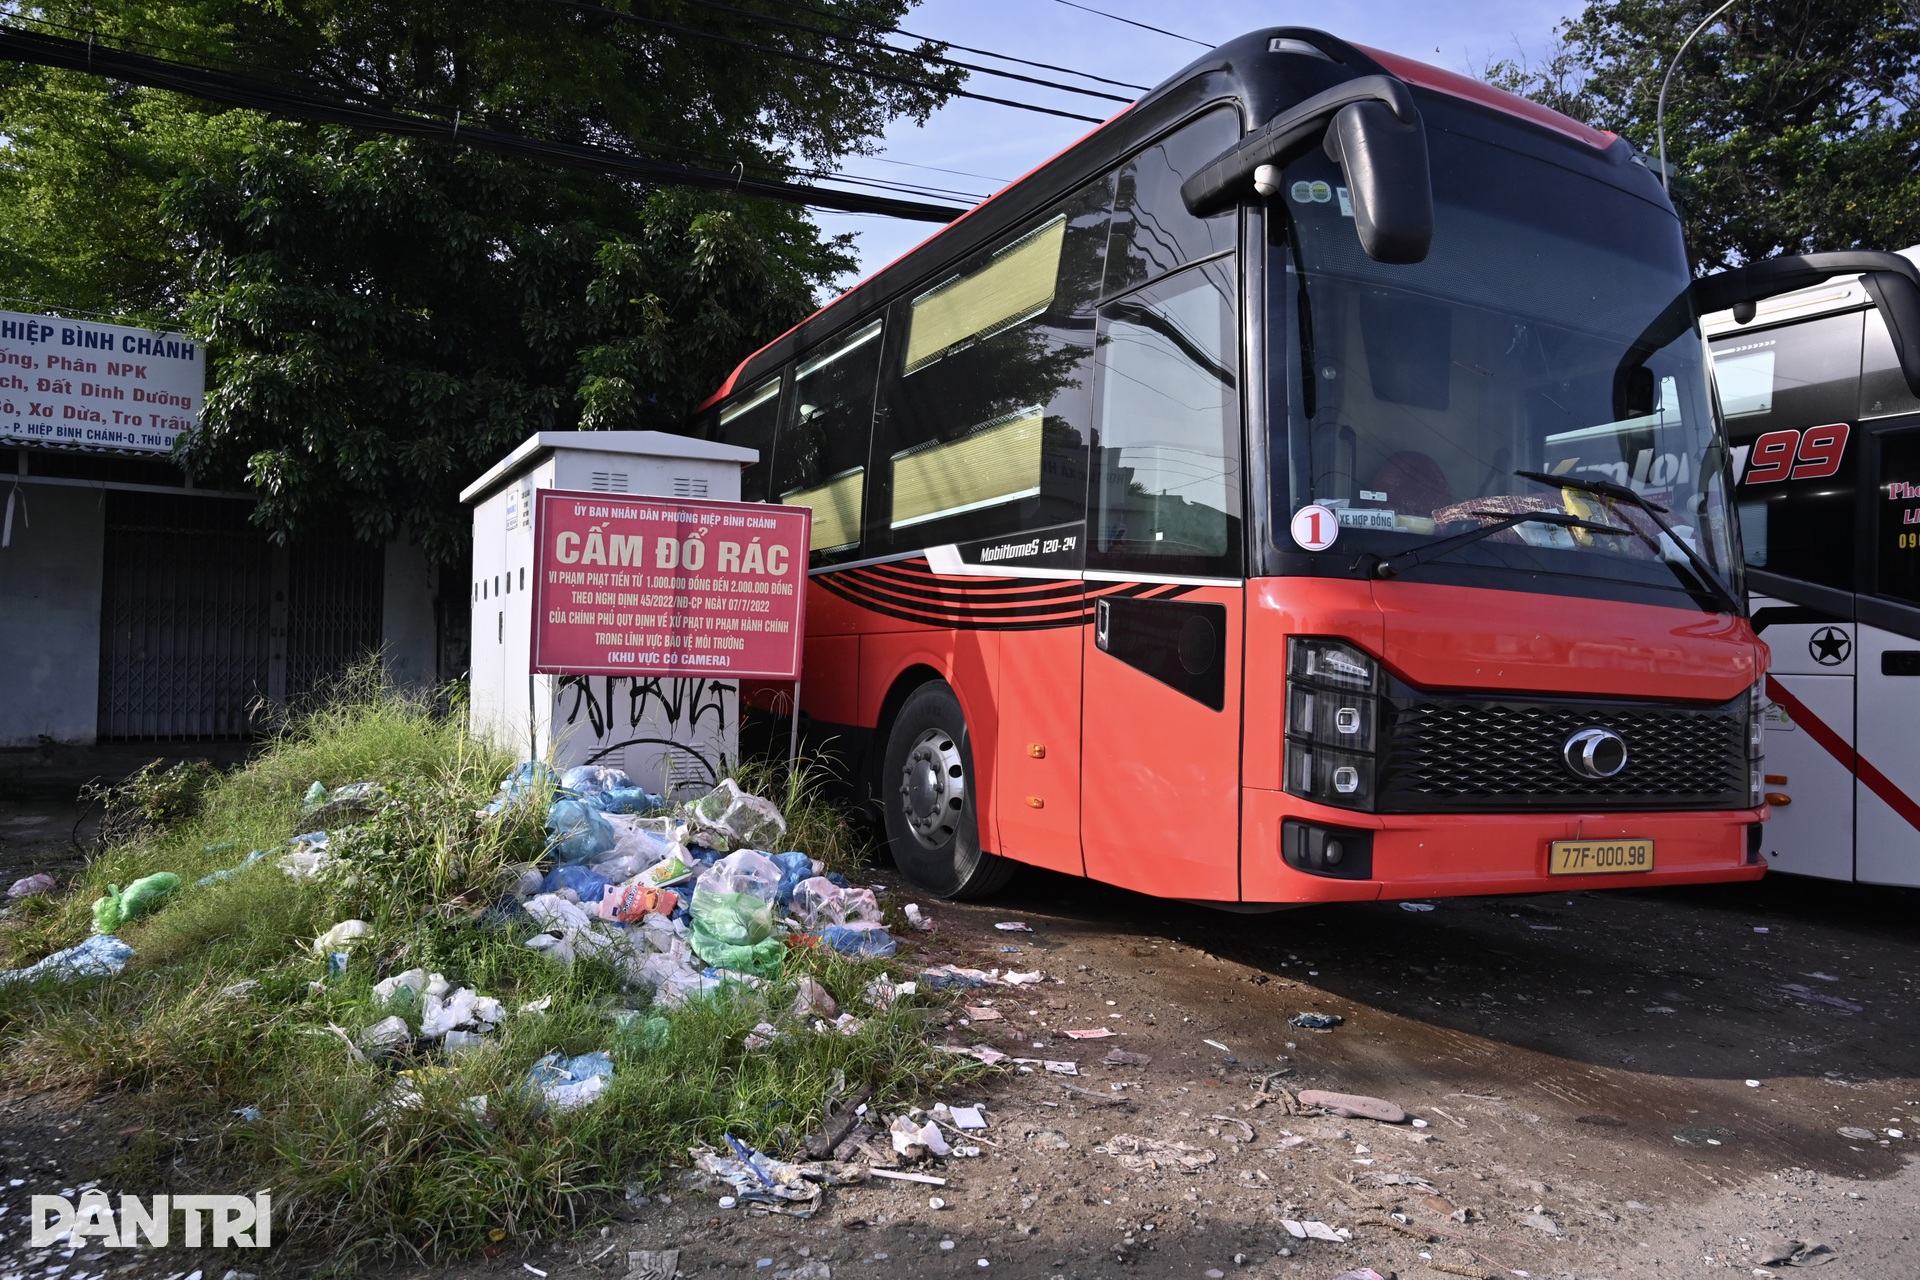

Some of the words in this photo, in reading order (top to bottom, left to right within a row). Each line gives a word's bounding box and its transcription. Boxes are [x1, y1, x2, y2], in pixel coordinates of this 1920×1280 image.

[2, 320, 54, 345] HIỆP
[62, 325, 114, 351] BÌNH
[122, 332, 194, 361] CHÁNH
[47, 355, 97, 373] Phân
[107, 362, 147, 379] NPK
[37, 378, 72, 394] Đất
[81, 382, 124, 400] Dinh
[133, 388, 191, 410] Dưỡng
[29, 402, 53, 417] Xơ
[63, 405, 107, 426] Dừa,
[112, 410, 142, 426] Tro
[149, 414, 191, 430] Trấu
[13, 422, 23, 433] P.
[28, 422, 53, 438] HIỆP
[57, 424, 82, 438] BÌNH
[1745, 423, 1850, 485] 99
[574, 502, 587, 516] ỦY
[589, 506, 609, 518] BAN
[611, 507, 637, 519] NHÂN
[640, 508, 659, 521] DÂN
[661, 510, 698, 524] PHƯỜNG
[701, 513, 721, 527] HIỆP
[723, 514, 744, 527] BÌNH
[746, 516, 777, 529] CHÁNH
[1339, 514, 1350, 525] XE
[1352, 513, 1368, 526] HỢP
[1305, 512, 1325, 544] 1
[556, 522, 643, 567] CẤM
[655, 527, 708, 571] ĐỔ
[717, 536, 789, 576] RÁC
[1042, 537, 1076, 554] 120-24
[1899, 533, 1920, 549] 09
[549, 571, 557, 583] VI
[559, 571, 585, 587] PHẠM
[587, 573, 609, 588] PHẠT
[611, 570, 631, 587] TIỀN
[632, 573, 643, 588] TỪ
[646, 576, 686, 590] 1.000.000
[713, 576, 729, 592] ĐẾN
[731, 580, 769, 594] 2.000.000
[572, 591, 593, 604] THEO
[595, 592, 616, 608] NGHỊ
[618, 593, 638, 608] ĐỊNH
[640, 594, 703, 610] 45/2022/NĐ-CP
[705, 596, 727, 610] NGÀY
[728, 598, 770, 612] 07/7/2022
[549, 607, 567, 624] CỦA
[569, 610, 595, 625] CHÍNH
[597, 609, 614, 626] PHỦ
[616, 613, 633, 627] QUY
[635, 614, 655, 629] ĐỊNH
[669, 612, 682, 628] XỬ
[683, 616, 704, 631] PHẠT
[706, 617, 714, 630] VI
[715, 618, 739, 633] PHẠM
[741, 617, 763, 632] HÀNH
[765, 618, 789, 633] CHÍNH
[595, 632, 622, 646] TRONG
[625, 631, 644, 646] LĨNH
[646, 633, 662, 649] VỰC
[664, 631, 681, 648] BẢO
[683, 633, 693, 651] VỆ
[695, 633, 711, 649] MÔI
[713, 634, 744, 650] TRƯỜNG
[608, 652, 635, 663] (KHU
[638, 653, 660, 666] VỰC
[663, 652, 678, 664] CÓ
[681, 653, 731, 667] CAMERA)
